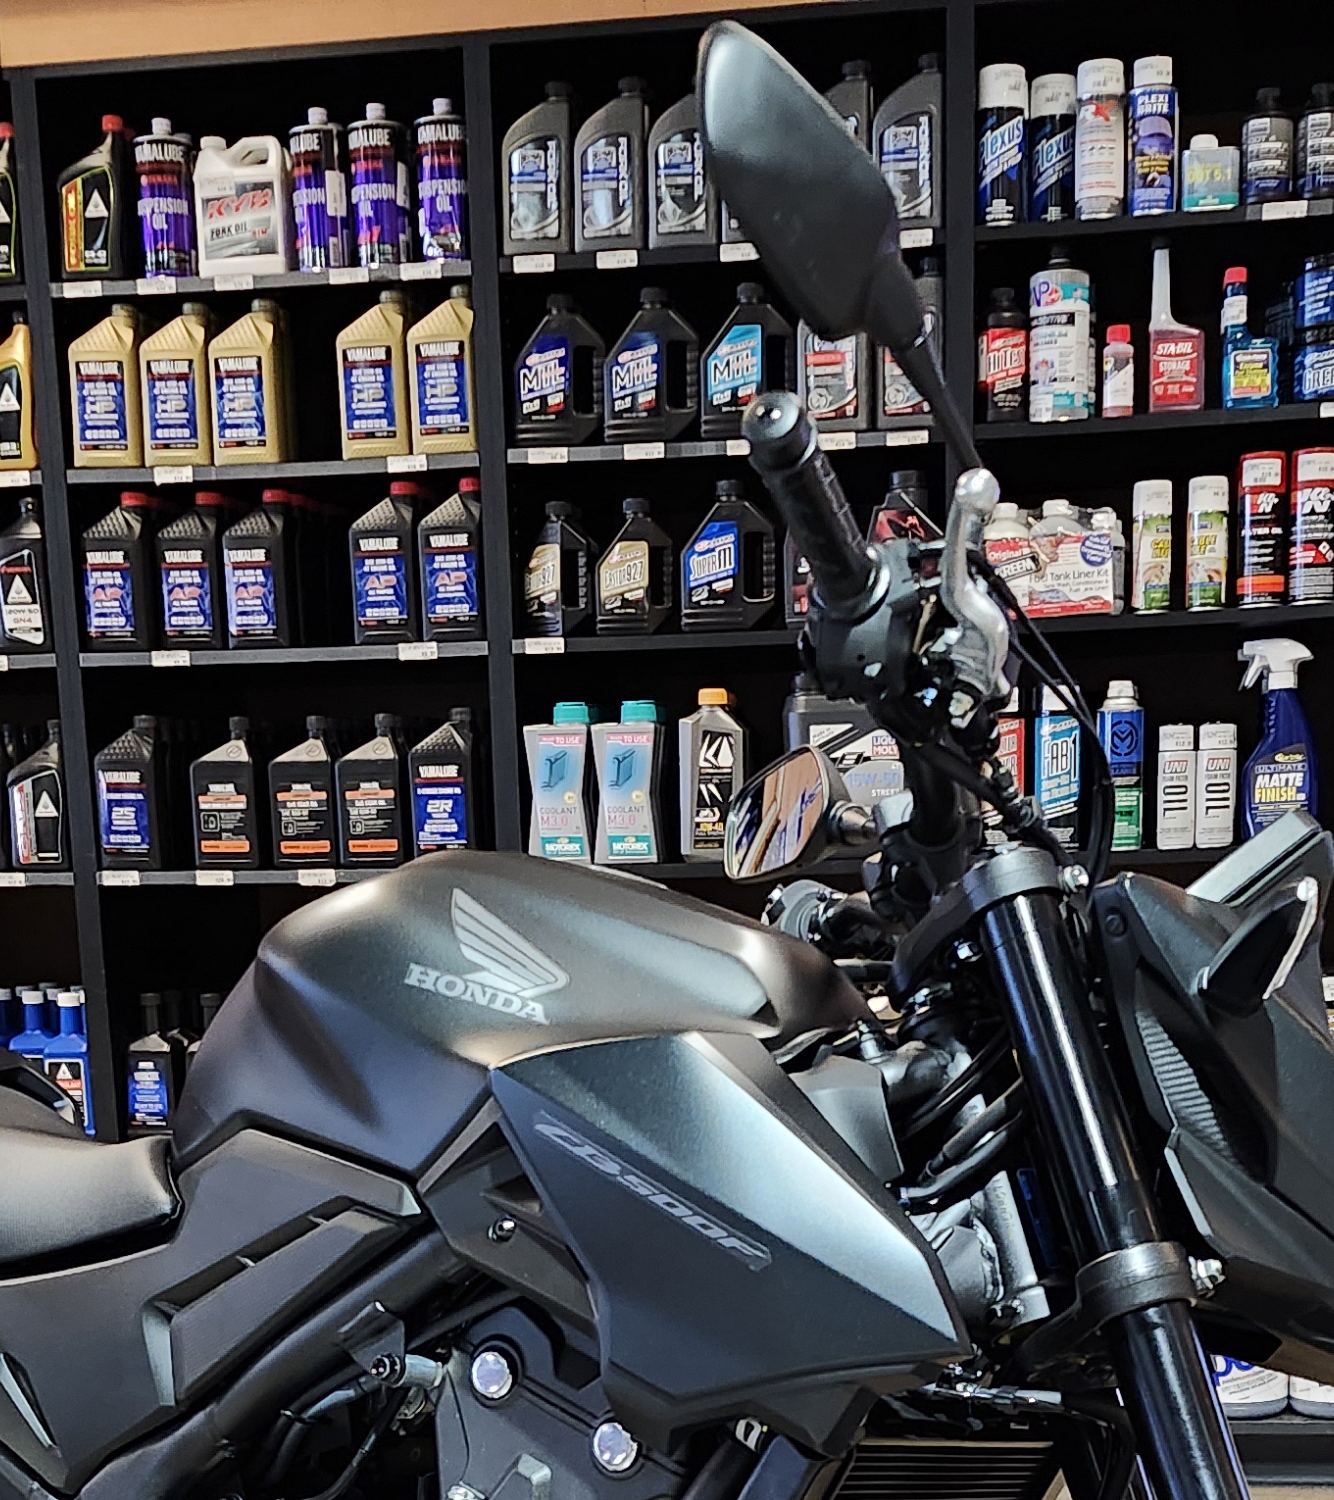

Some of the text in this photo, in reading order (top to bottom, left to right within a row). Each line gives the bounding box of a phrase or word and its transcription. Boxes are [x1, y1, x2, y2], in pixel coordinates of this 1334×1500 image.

[1138, 94, 1169, 104] PLEXI
[1138, 103, 1169, 115] BRITE
[980, 115, 1023, 168] Plexus
[209, 189, 272, 219] KYB
[437, 197, 453, 213] OIL
[152, 214, 167, 230] OIL
[210, 221, 247, 241] FORK OIL
[1156, 342, 1193, 355] STA-BIL
[989, 551, 1023, 562] Original
[1050, 568, 1109, 582] Tank Liner Kit
[555, 735, 580, 744] TO USE
[624, 735, 648, 744] TO USE
[872, 745, 899, 756] MOLY
[419, 765, 459, 778] YAMALUBE
[1164, 761, 1188, 774] UNI
[1207, 758, 1230, 772] UNI
[1255, 764, 1307, 773] ULTIMATE
[1255, 772, 1304, 788] MATTE
[872, 788, 900, 797] STREET
[1205, 781, 1230, 816] OIL
[1254, 786, 1297, 804] FINISH
[427, 799, 453, 813] 2R
[1163, 783, 1188, 819] OIL
[540, 806, 577, 815] COOLANT
[607, 806, 645, 815] COOLANT
[540, 815, 569, 827] M3.0
[607, 814, 636, 827] M3.0
[545, 842, 583, 853] MOTOREX
[612, 842, 651, 853] MOTOREX
[404, 962, 551, 1025] HONDA
[534, 1121, 771, 1272] CB500F
